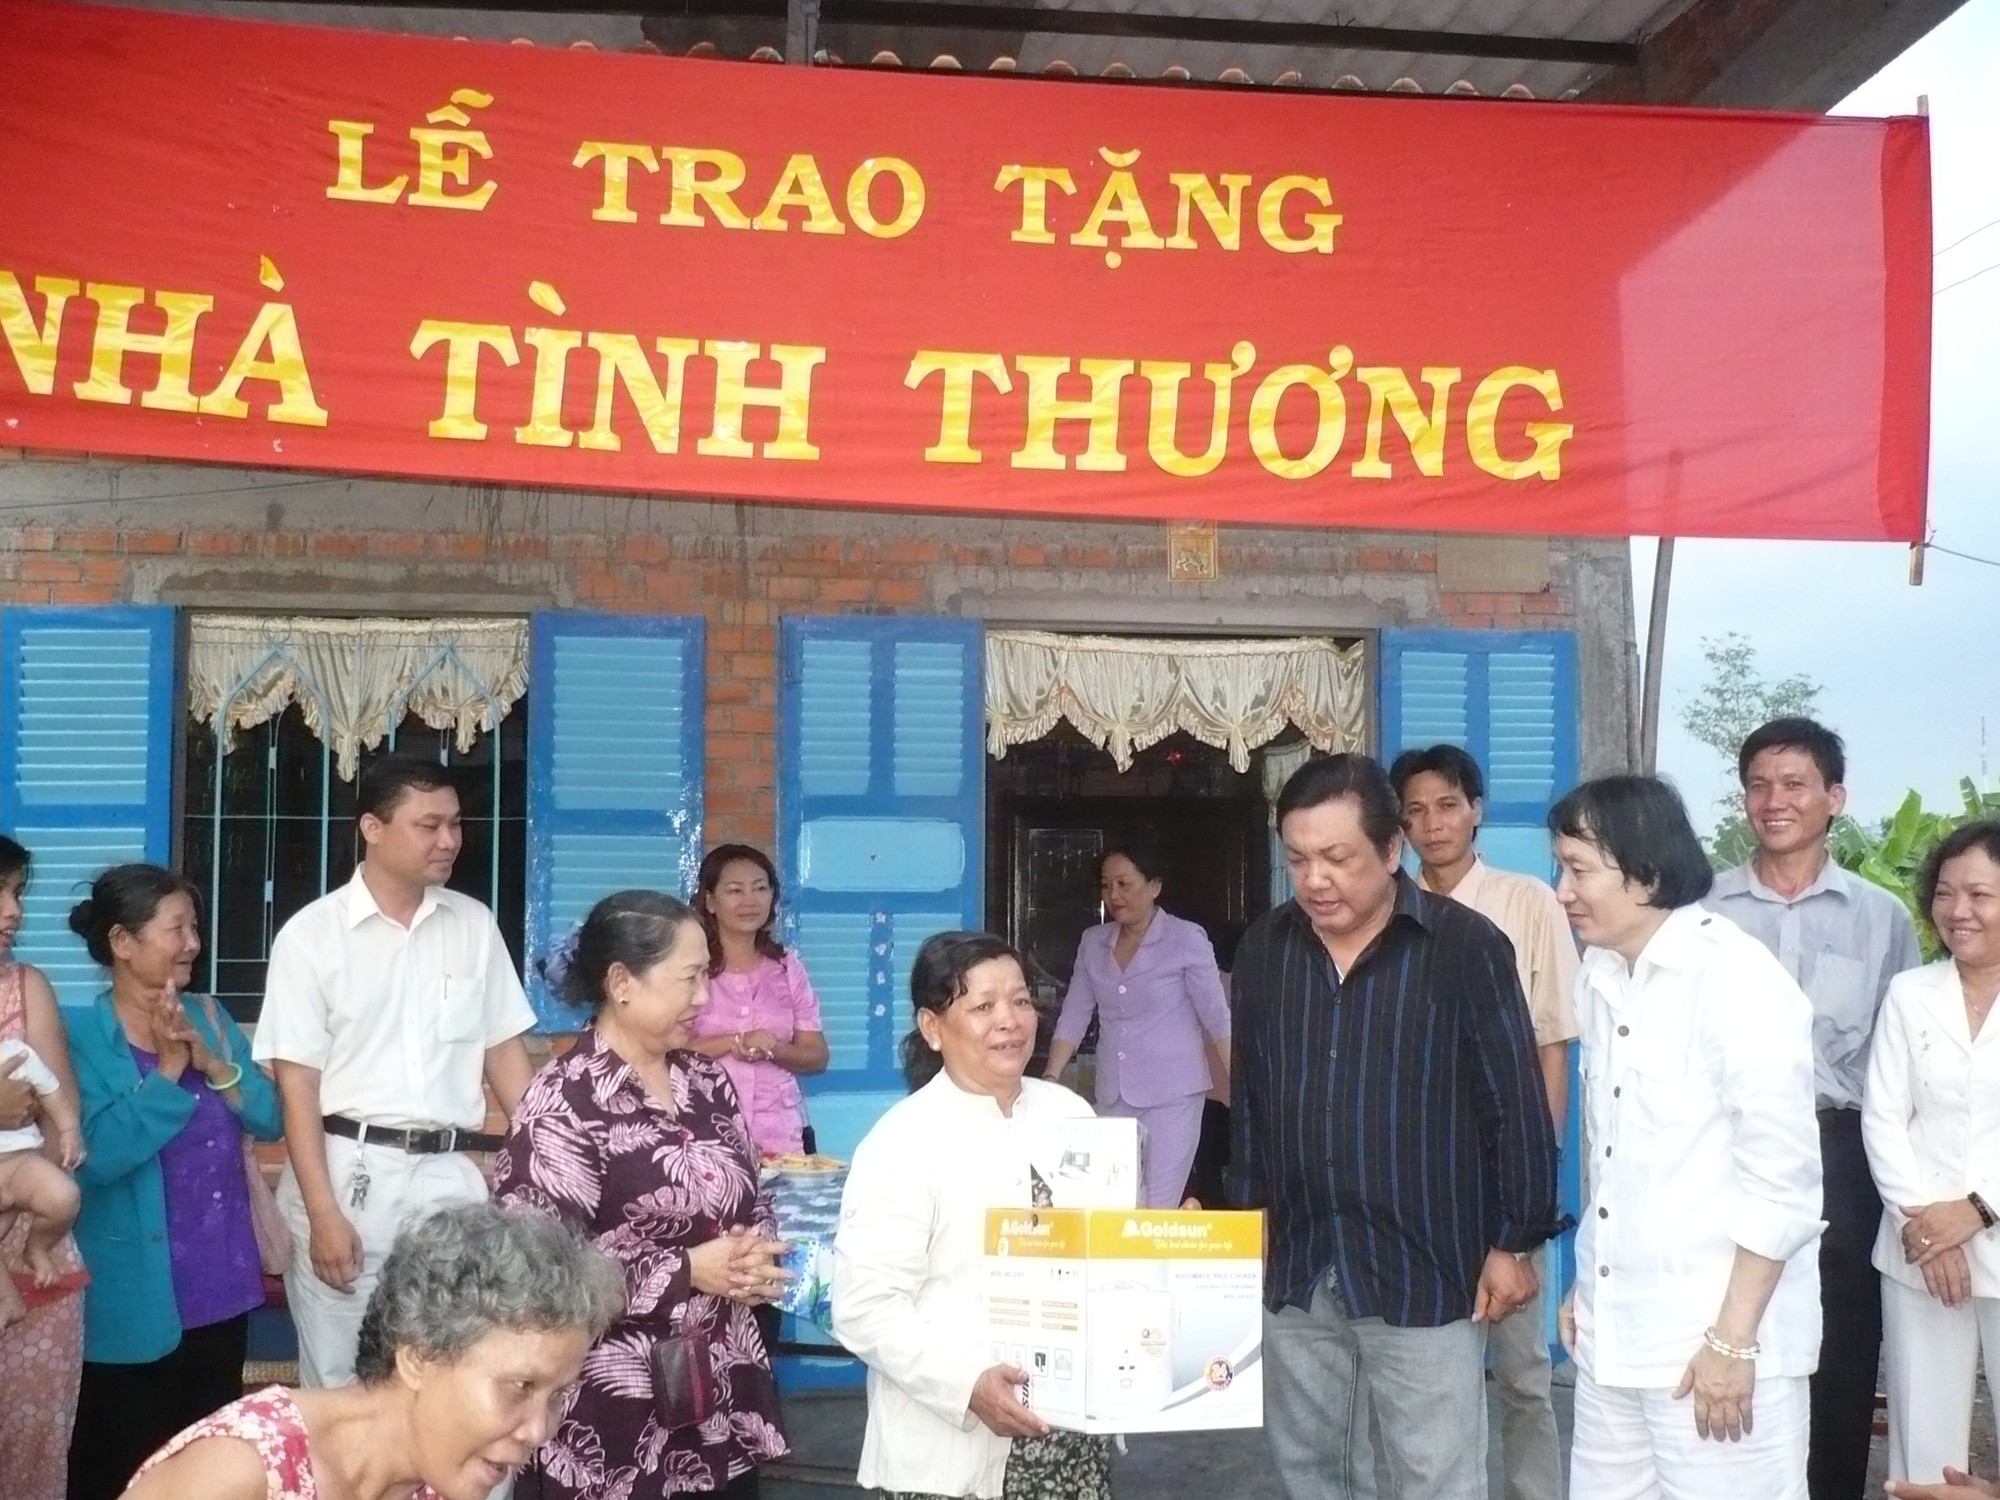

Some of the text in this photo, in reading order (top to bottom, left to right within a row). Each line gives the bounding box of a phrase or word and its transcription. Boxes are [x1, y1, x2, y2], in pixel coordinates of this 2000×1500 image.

[326, 88, 1343, 268] LỄ TRAO TẶNG
[0, 254, 1574, 481] NHÀ TÌNH THƯƠNG
[1140, 1221, 1208, 1238] Goldsun
